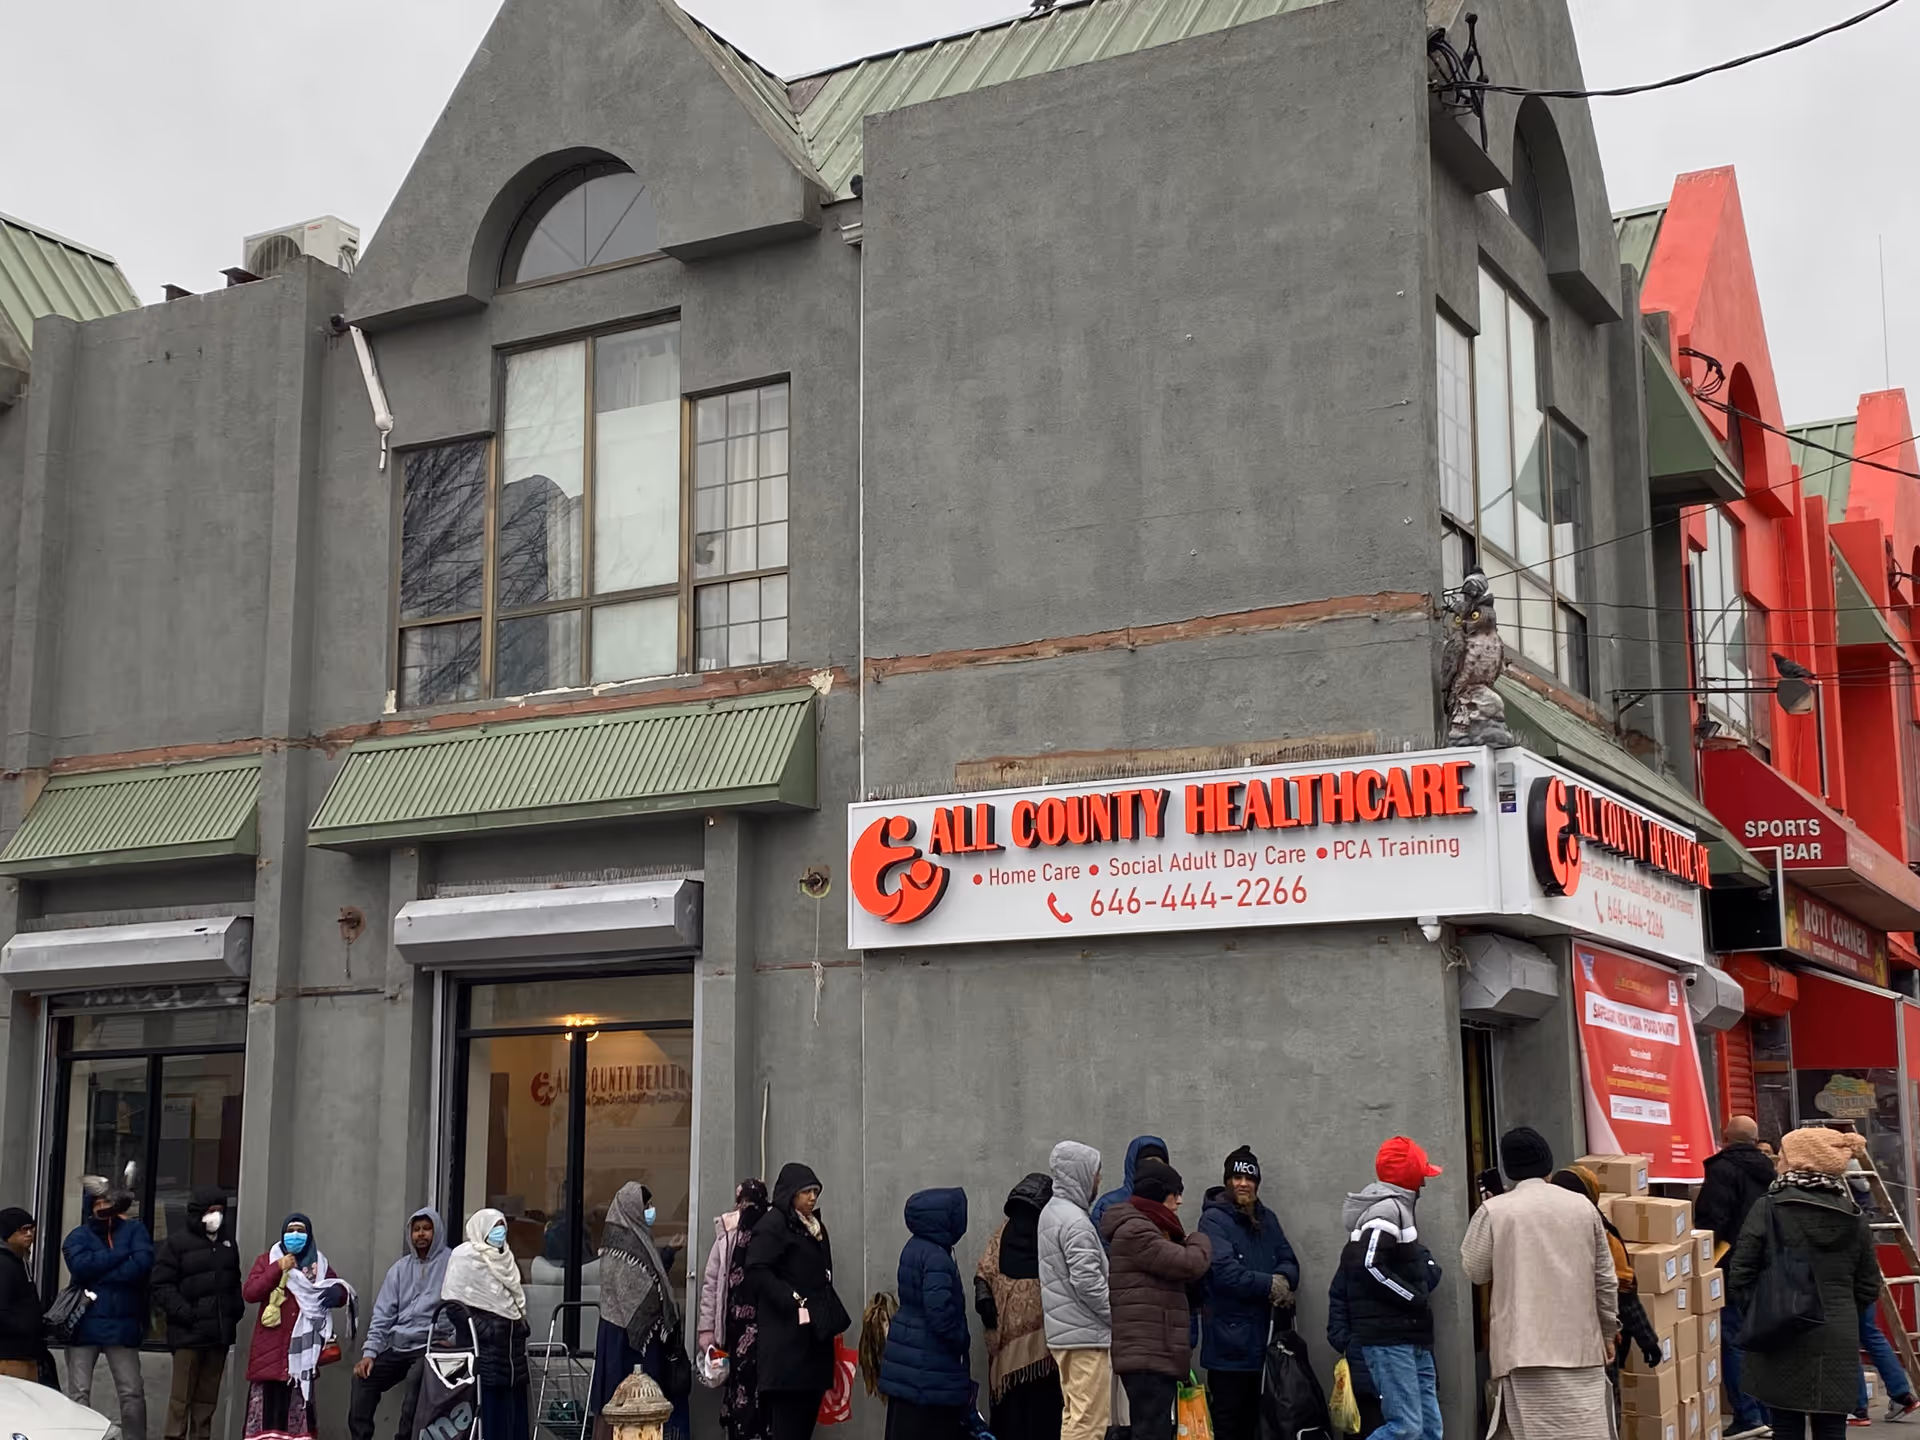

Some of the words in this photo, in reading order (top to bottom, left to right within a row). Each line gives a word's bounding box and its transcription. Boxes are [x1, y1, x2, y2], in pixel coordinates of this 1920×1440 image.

[929, 803, 1004, 854] ALL
[1011, 788, 1169, 848] COUNTY
[1185, 760, 1476, 834] HEALTHCARE
[1744, 818, 1821, 838] SPORTS
[989, 867, 1036, 886] Home
[1042, 862, 1081, 881] Care
[1109, 853, 1163, 876] Social
[1169, 851, 1217, 872] Adult
[1224, 847, 1258, 871] Day
[1265, 845, 1307, 865] Care
[1333, 839, 1373, 860] PCA
[1378, 834, 1460, 858] Training
[1575, 786, 1599, 840] ALL
[1600, 796, 1645, 861] COUNTY
[1648, 820, 1712, 890] HEALTHCARE
[1783, 842, 1822, 860] BAR
[1090, 875, 1308, 917] 646-444-2266
[1803, 899, 1829, 939] ROTI
[1831, 914, 1870, 959] CORNER
[586, 1065, 632, 1092] OUNTY
